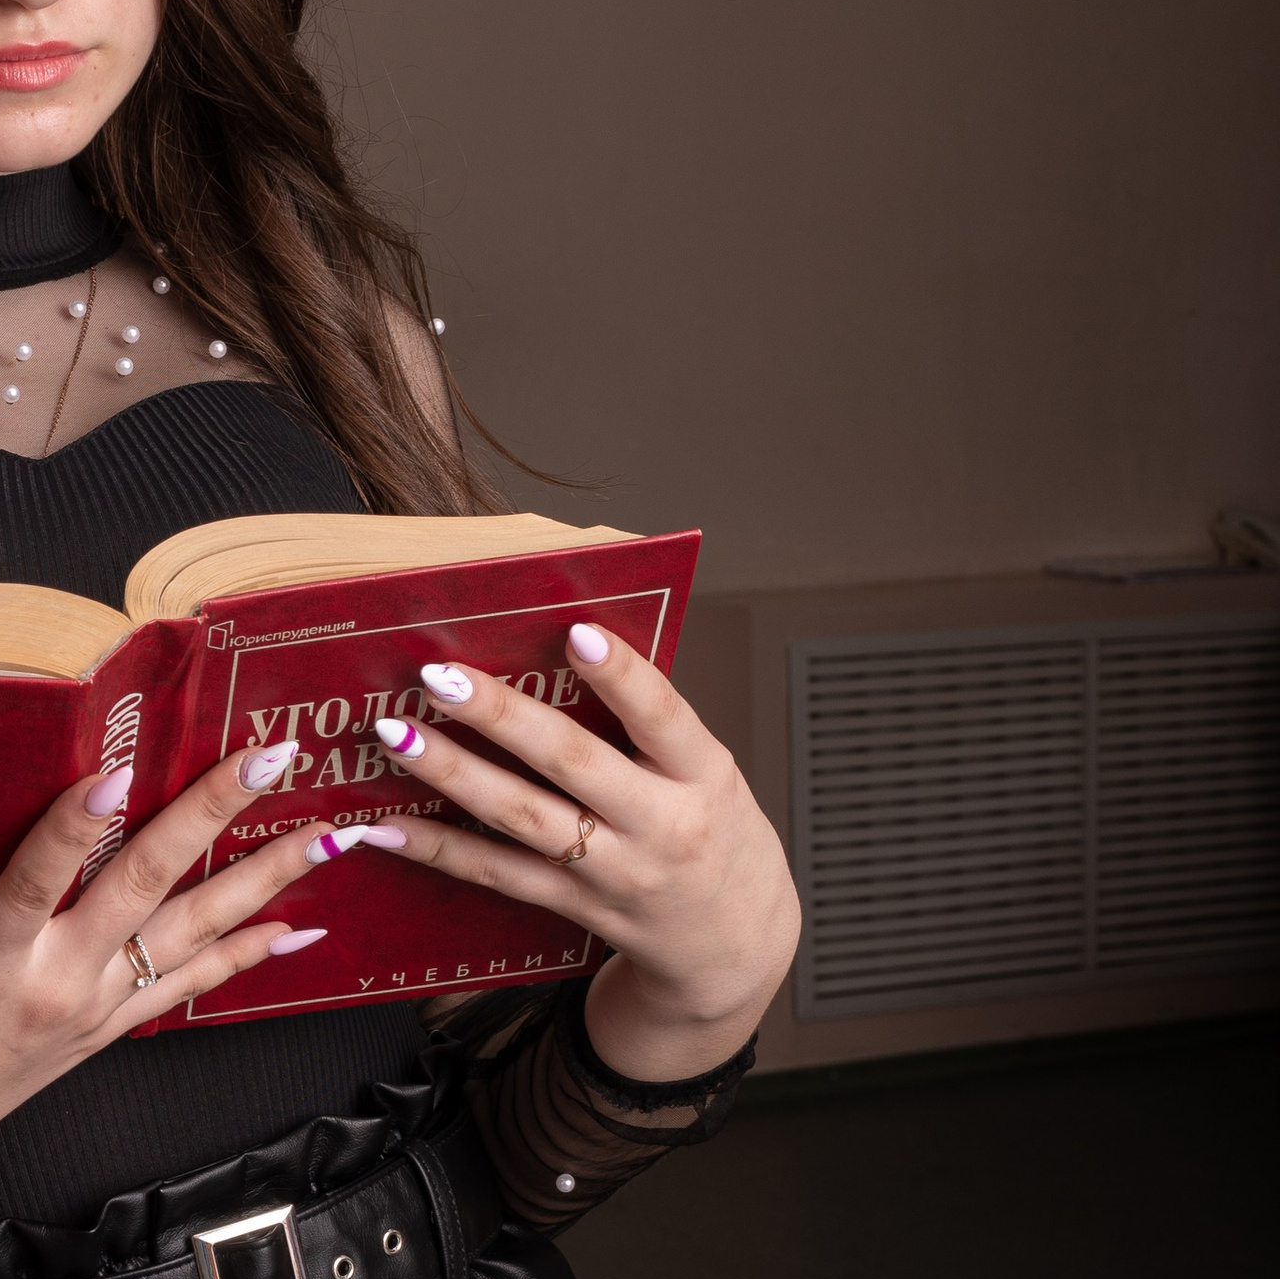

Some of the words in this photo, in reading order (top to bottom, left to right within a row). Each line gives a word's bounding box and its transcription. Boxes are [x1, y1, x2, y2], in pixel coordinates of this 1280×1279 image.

[229, 620, 356, 648] Юриспруденция
[99, 692, 143, 776] РАВО
[246, 667, 583, 749] УГОЛООЕ
[258, 740, 416, 796] РАВ
[358, 949, 577, 990] УЧЕБНИК
